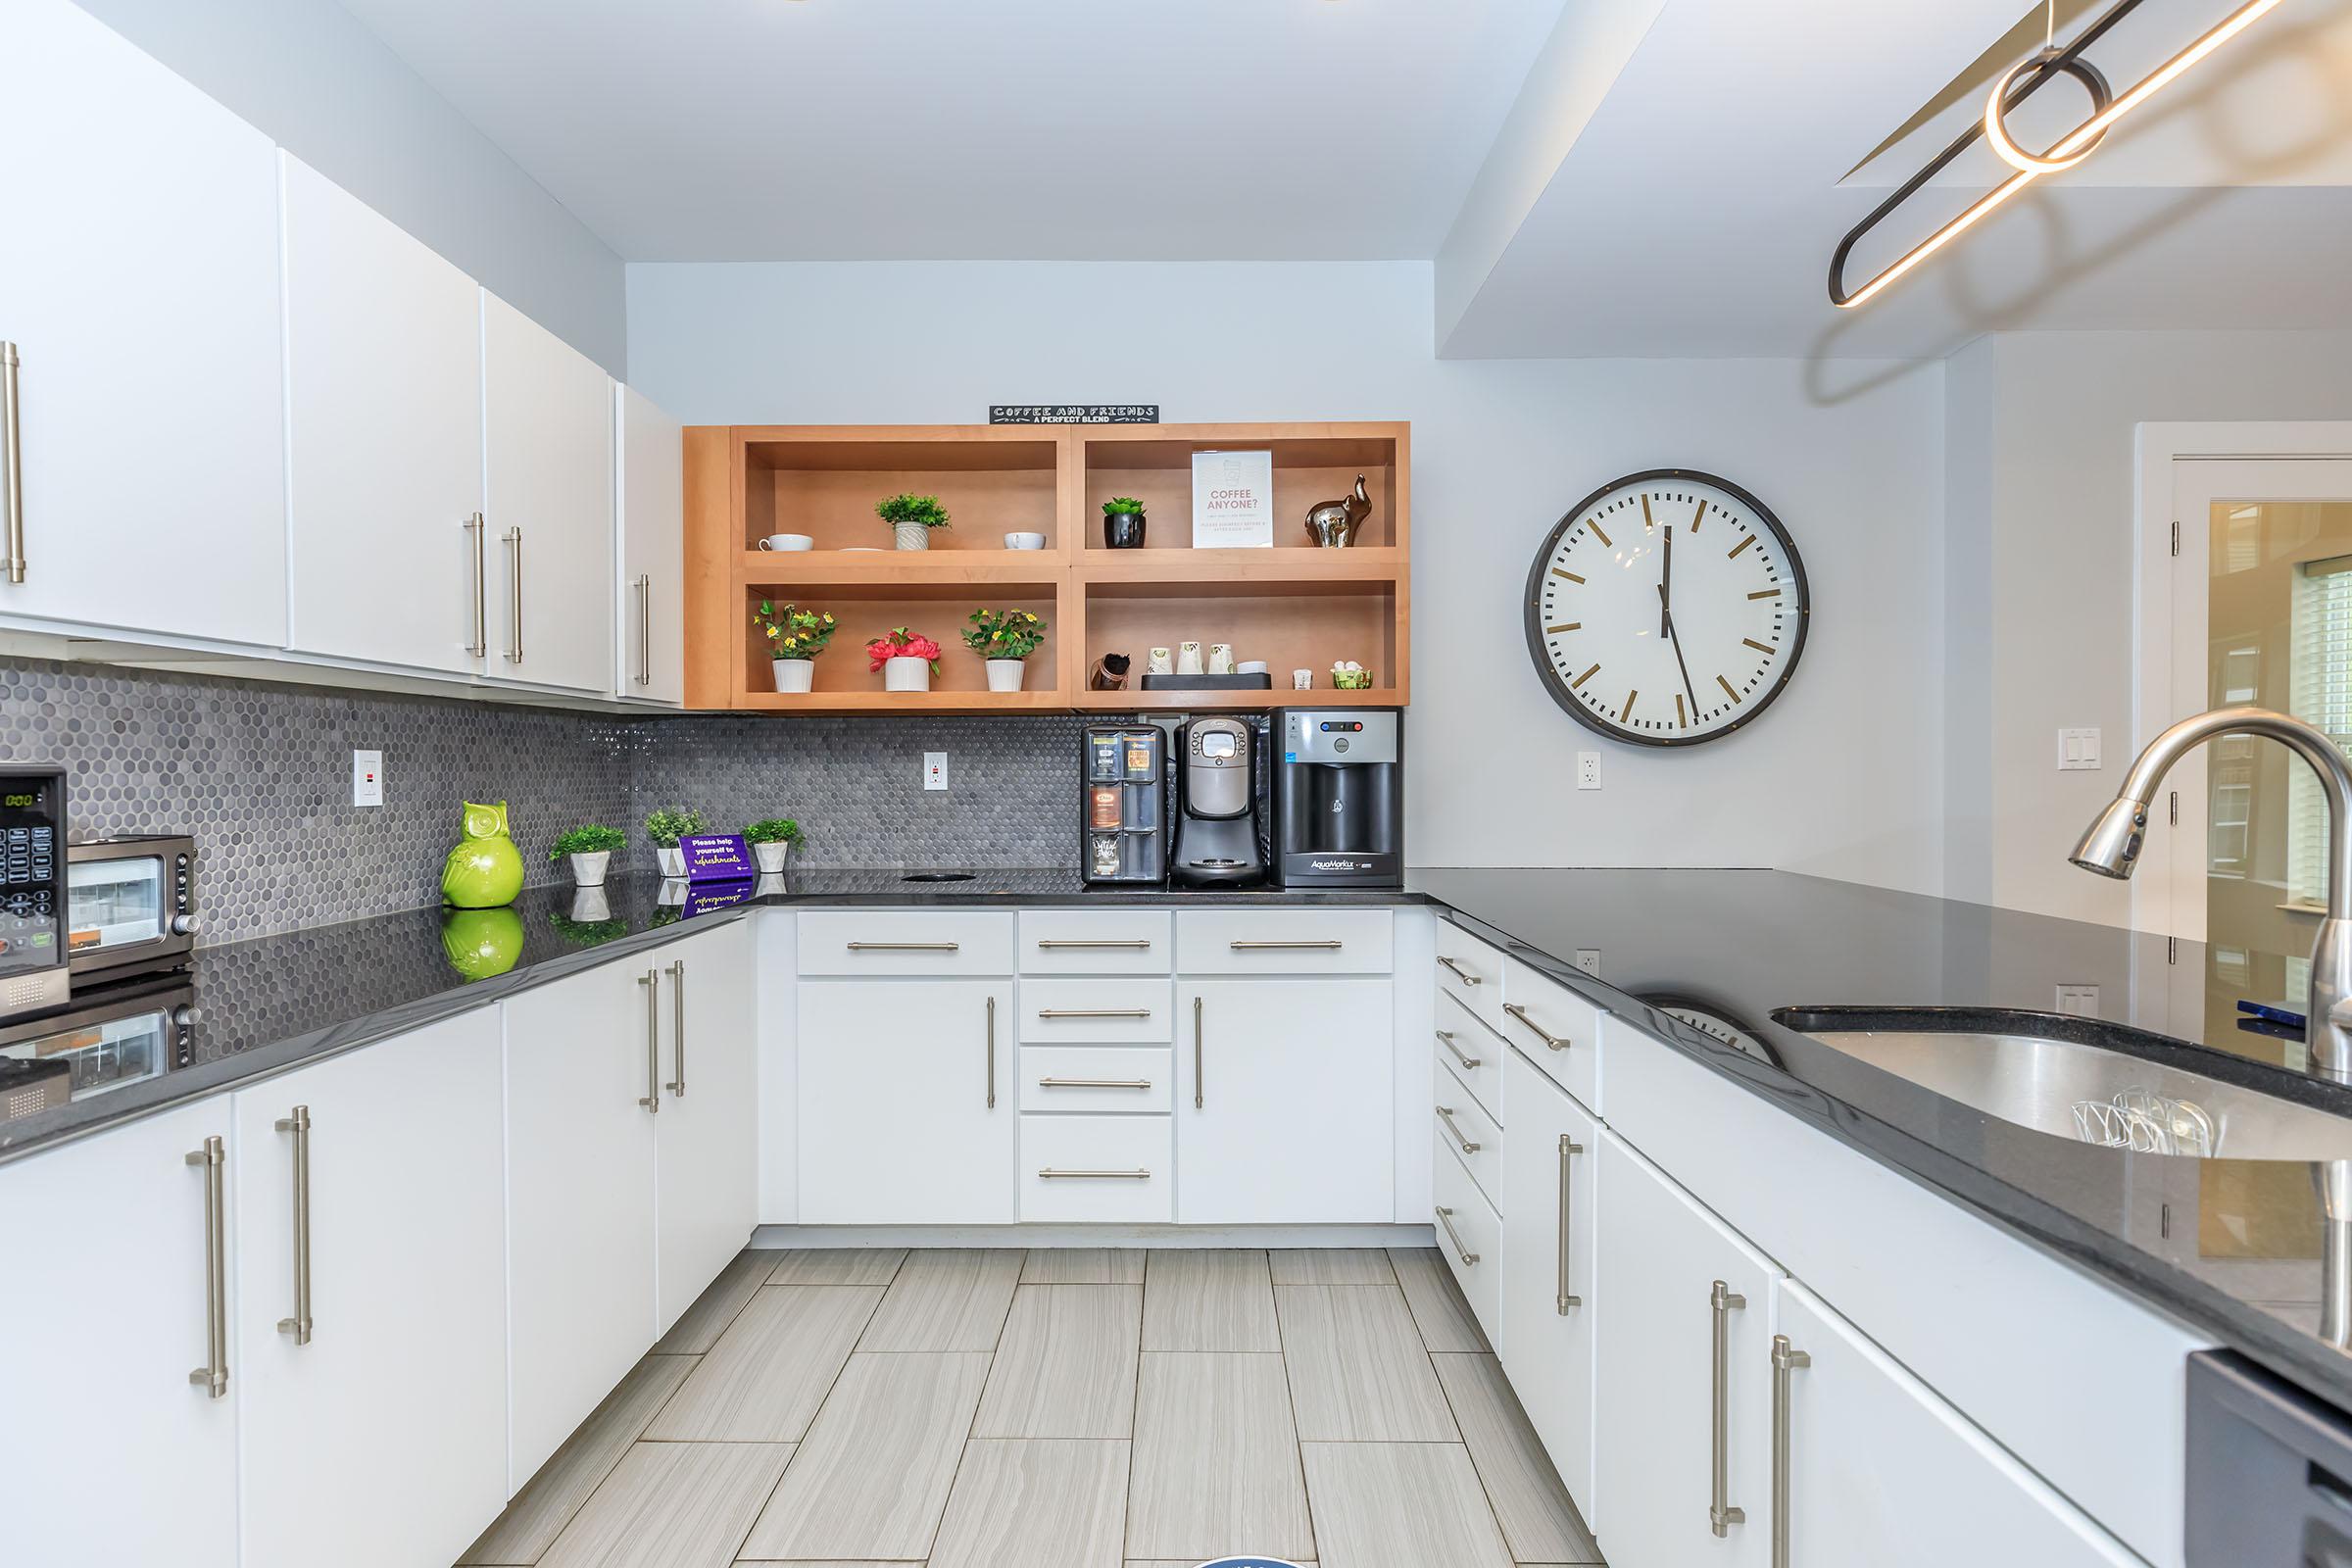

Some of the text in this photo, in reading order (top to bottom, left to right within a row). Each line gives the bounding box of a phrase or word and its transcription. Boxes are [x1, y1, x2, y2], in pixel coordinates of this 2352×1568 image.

[994, 407, 1154, 416] COFFEE AND FRIENDS
[1210, 489, 1251, 499] COFFEE
[1207, 499, 1258, 510] ANYONE?
[695, 847, 724, 856] yourself
[694, 855, 741, 866] refreshments
